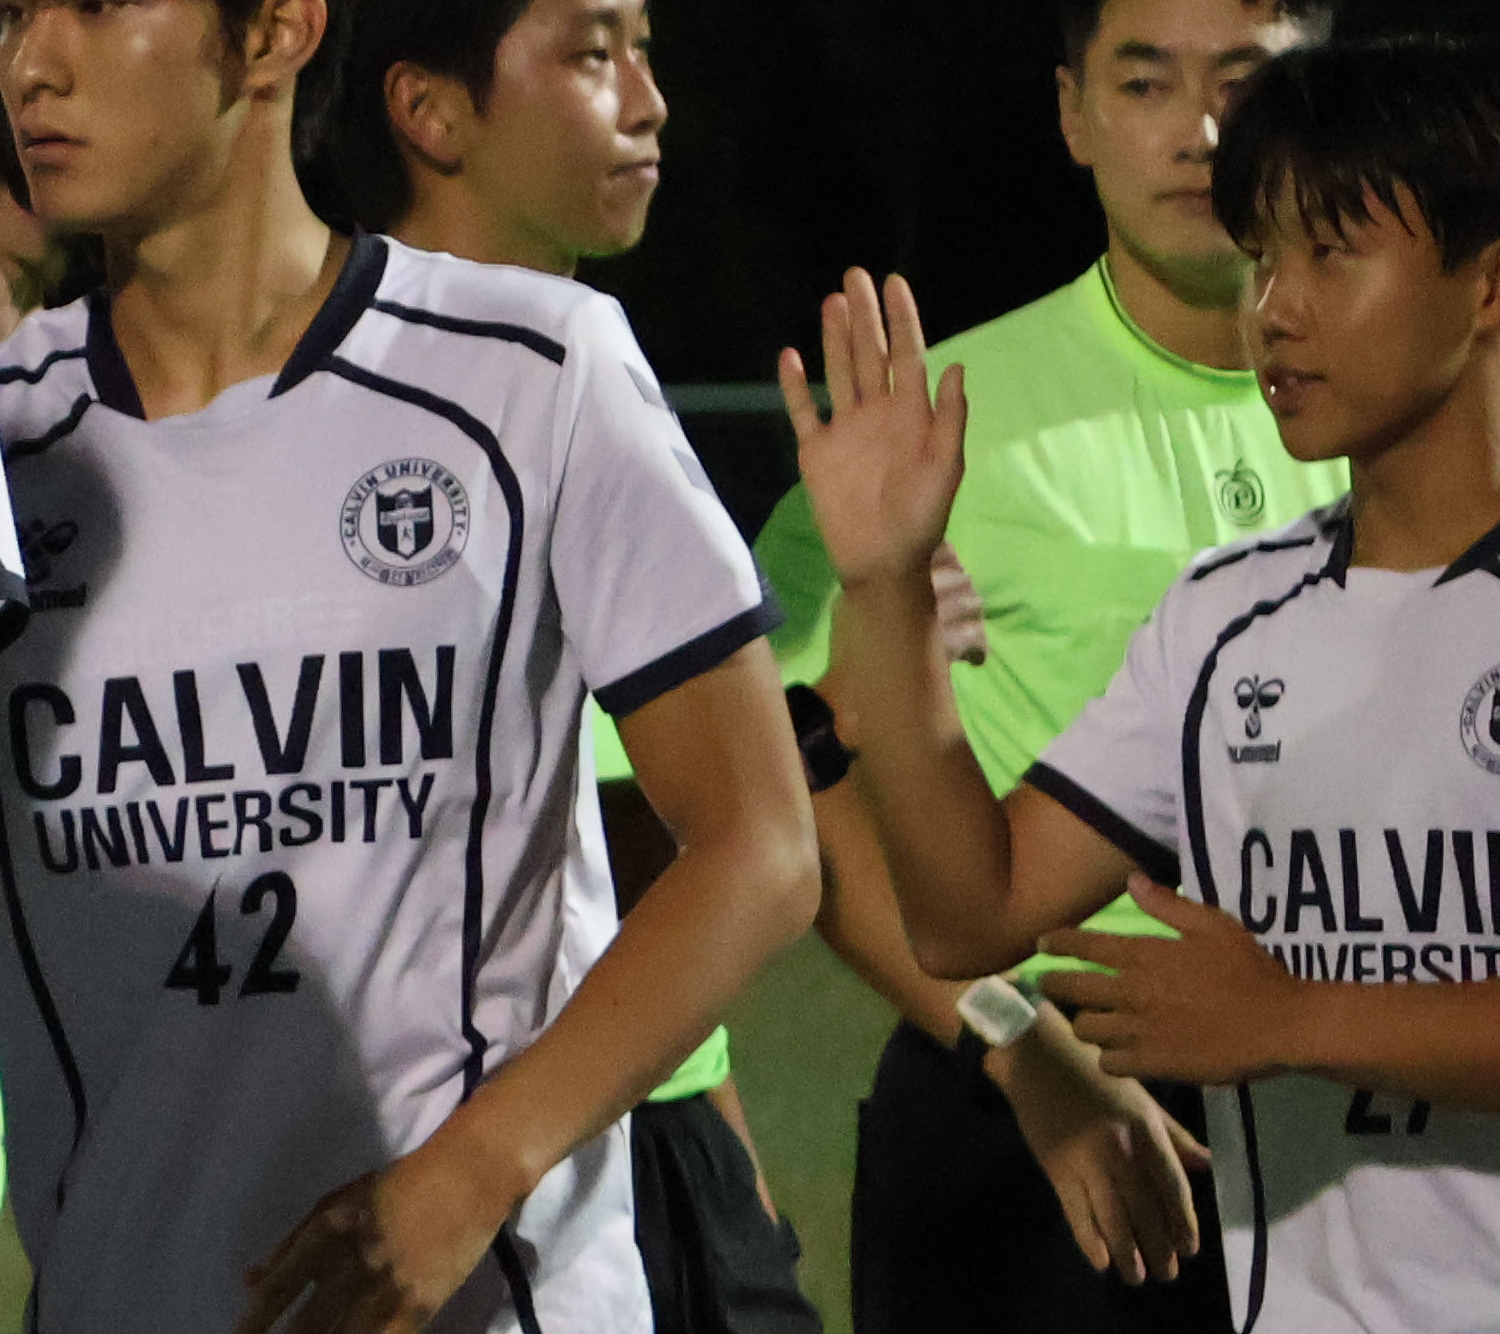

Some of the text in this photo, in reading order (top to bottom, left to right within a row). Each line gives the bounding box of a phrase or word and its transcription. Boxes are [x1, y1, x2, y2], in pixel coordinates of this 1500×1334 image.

[7, 645, 456, 802] CALVIN
[33, 774, 435, 873] UNIVERSITY
[164, 871, 299, 1006] 42
